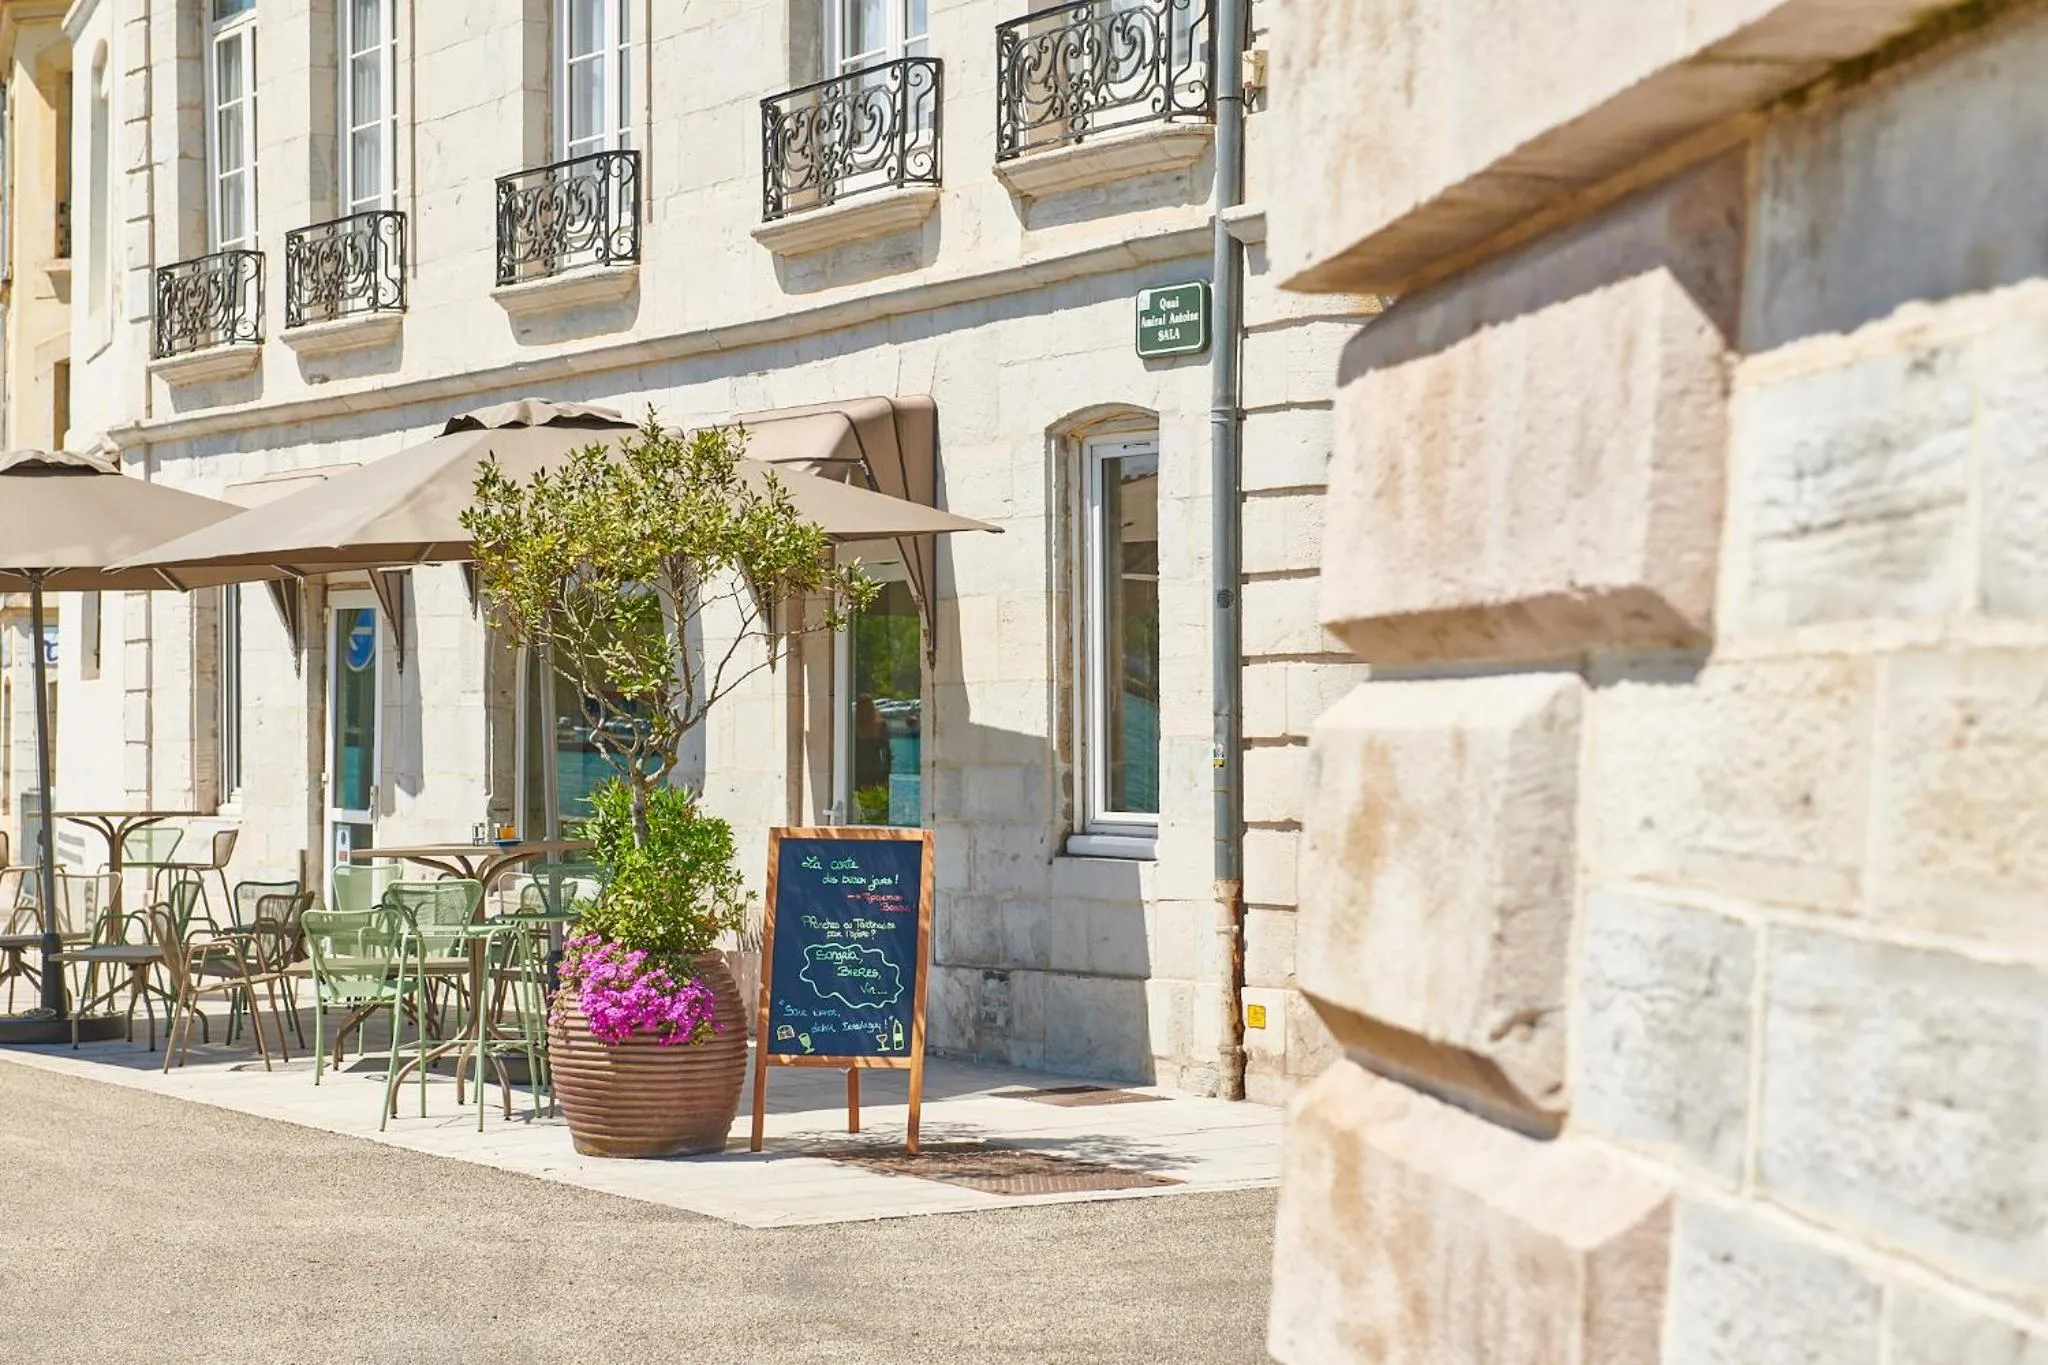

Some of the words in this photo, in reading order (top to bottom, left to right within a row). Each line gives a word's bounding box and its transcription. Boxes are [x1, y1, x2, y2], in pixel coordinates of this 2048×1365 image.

[1159, 295, 1179, 311] Quai
[1141, 313, 1166, 328] Amiral
[1168, 310, 1199, 324] Antoine
[1157, 327, 1180, 342] SALA
[801, 855, 822, 870] La
